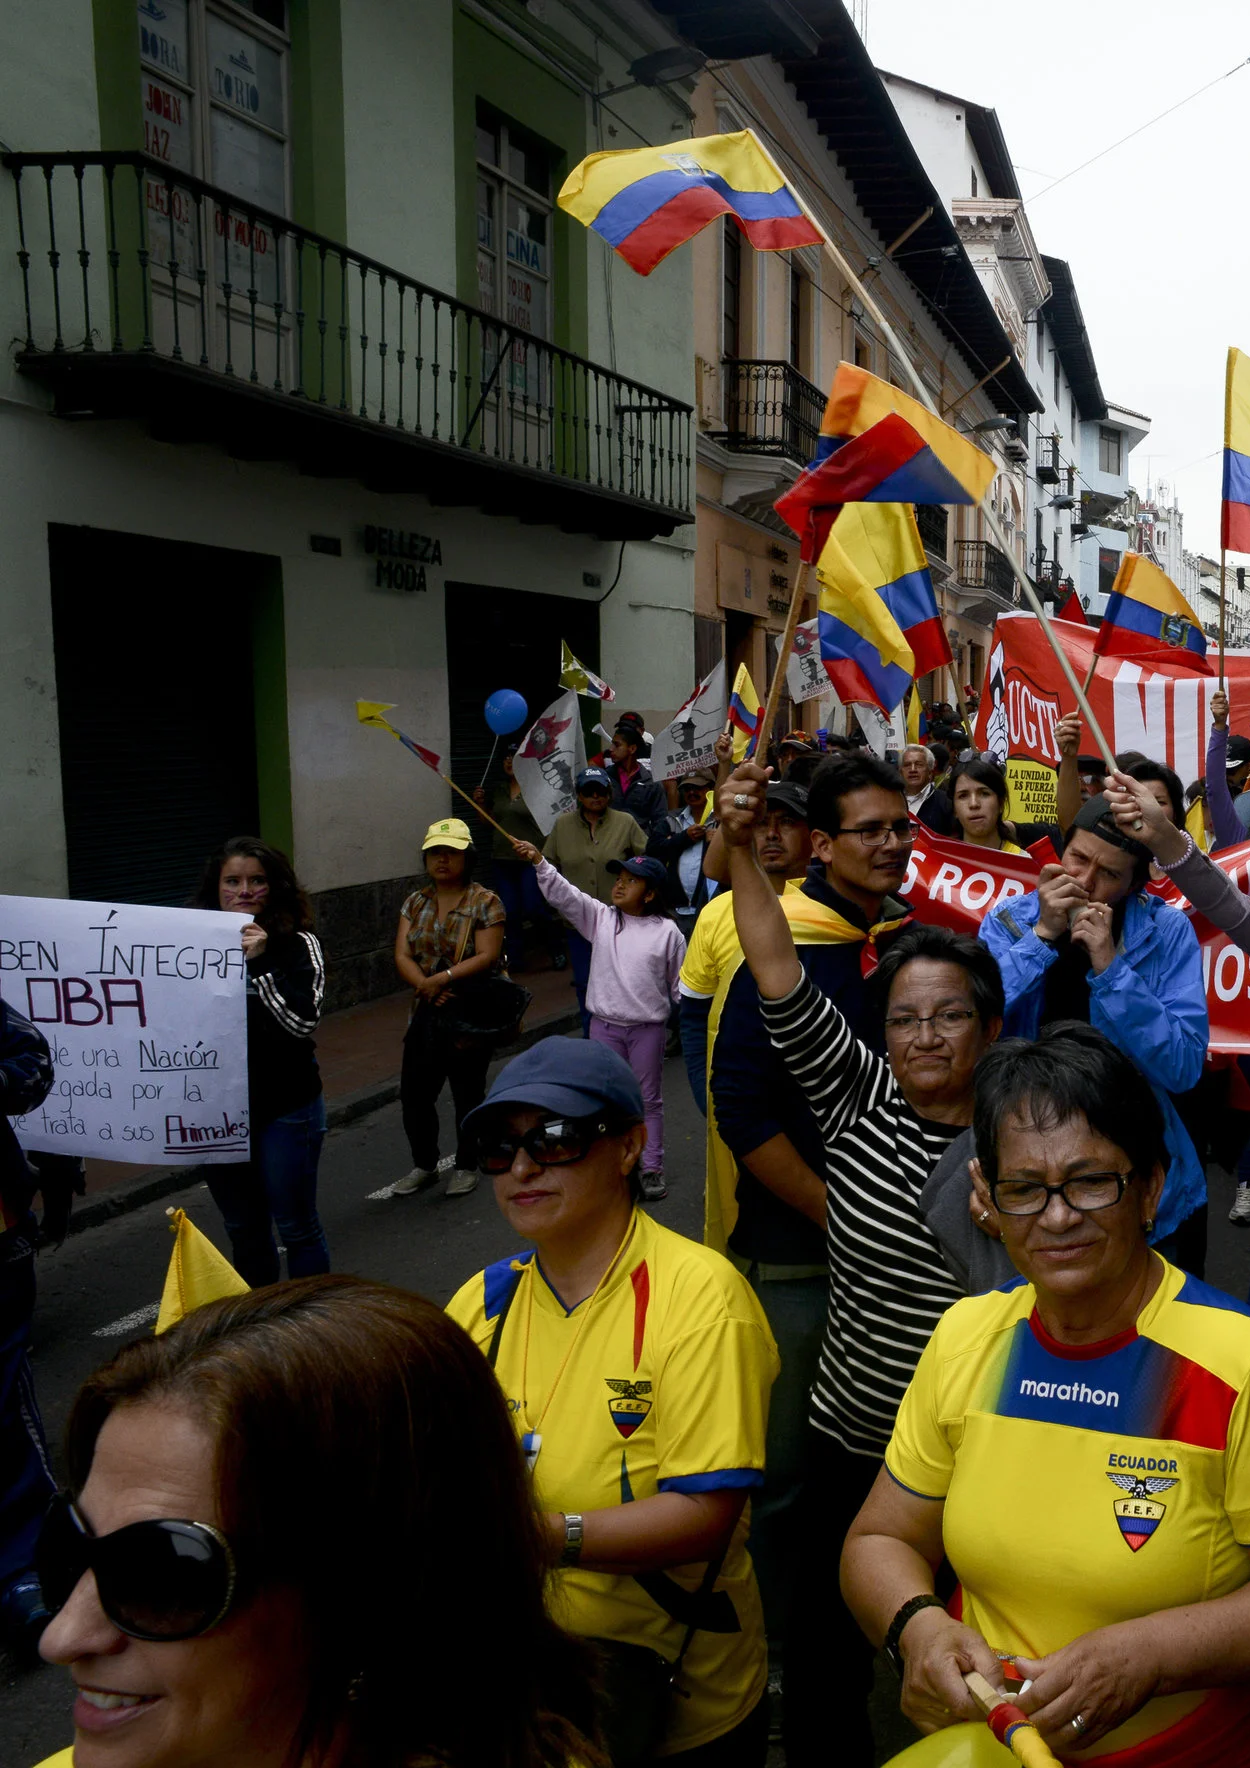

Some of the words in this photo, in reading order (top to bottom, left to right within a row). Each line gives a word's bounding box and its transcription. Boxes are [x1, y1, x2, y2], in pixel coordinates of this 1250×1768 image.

[376, 560, 427, 592] MODA
[1009, 769, 1018, 779] LA
[1020, 770, 1051, 781] UNIDAD
[1014, 781, 1023, 790] ES
[1025, 782, 1055, 793] FUERZA
[1020, 792, 1031, 802] LA
[82, 1048, 121, 1068] una
[139, 1040, 218, 1069] Nación
[132, 1082, 163, 1110] por
[184, 1074, 204, 1103] la
[41, 1107, 87, 1136] trata
[99, 1122, 113, 1140] a
[121, 1124, 155, 1142] sus
[1020, 1379, 1119, 1408] marathon
[1108, 1453, 1178, 1473] ECUADOR
